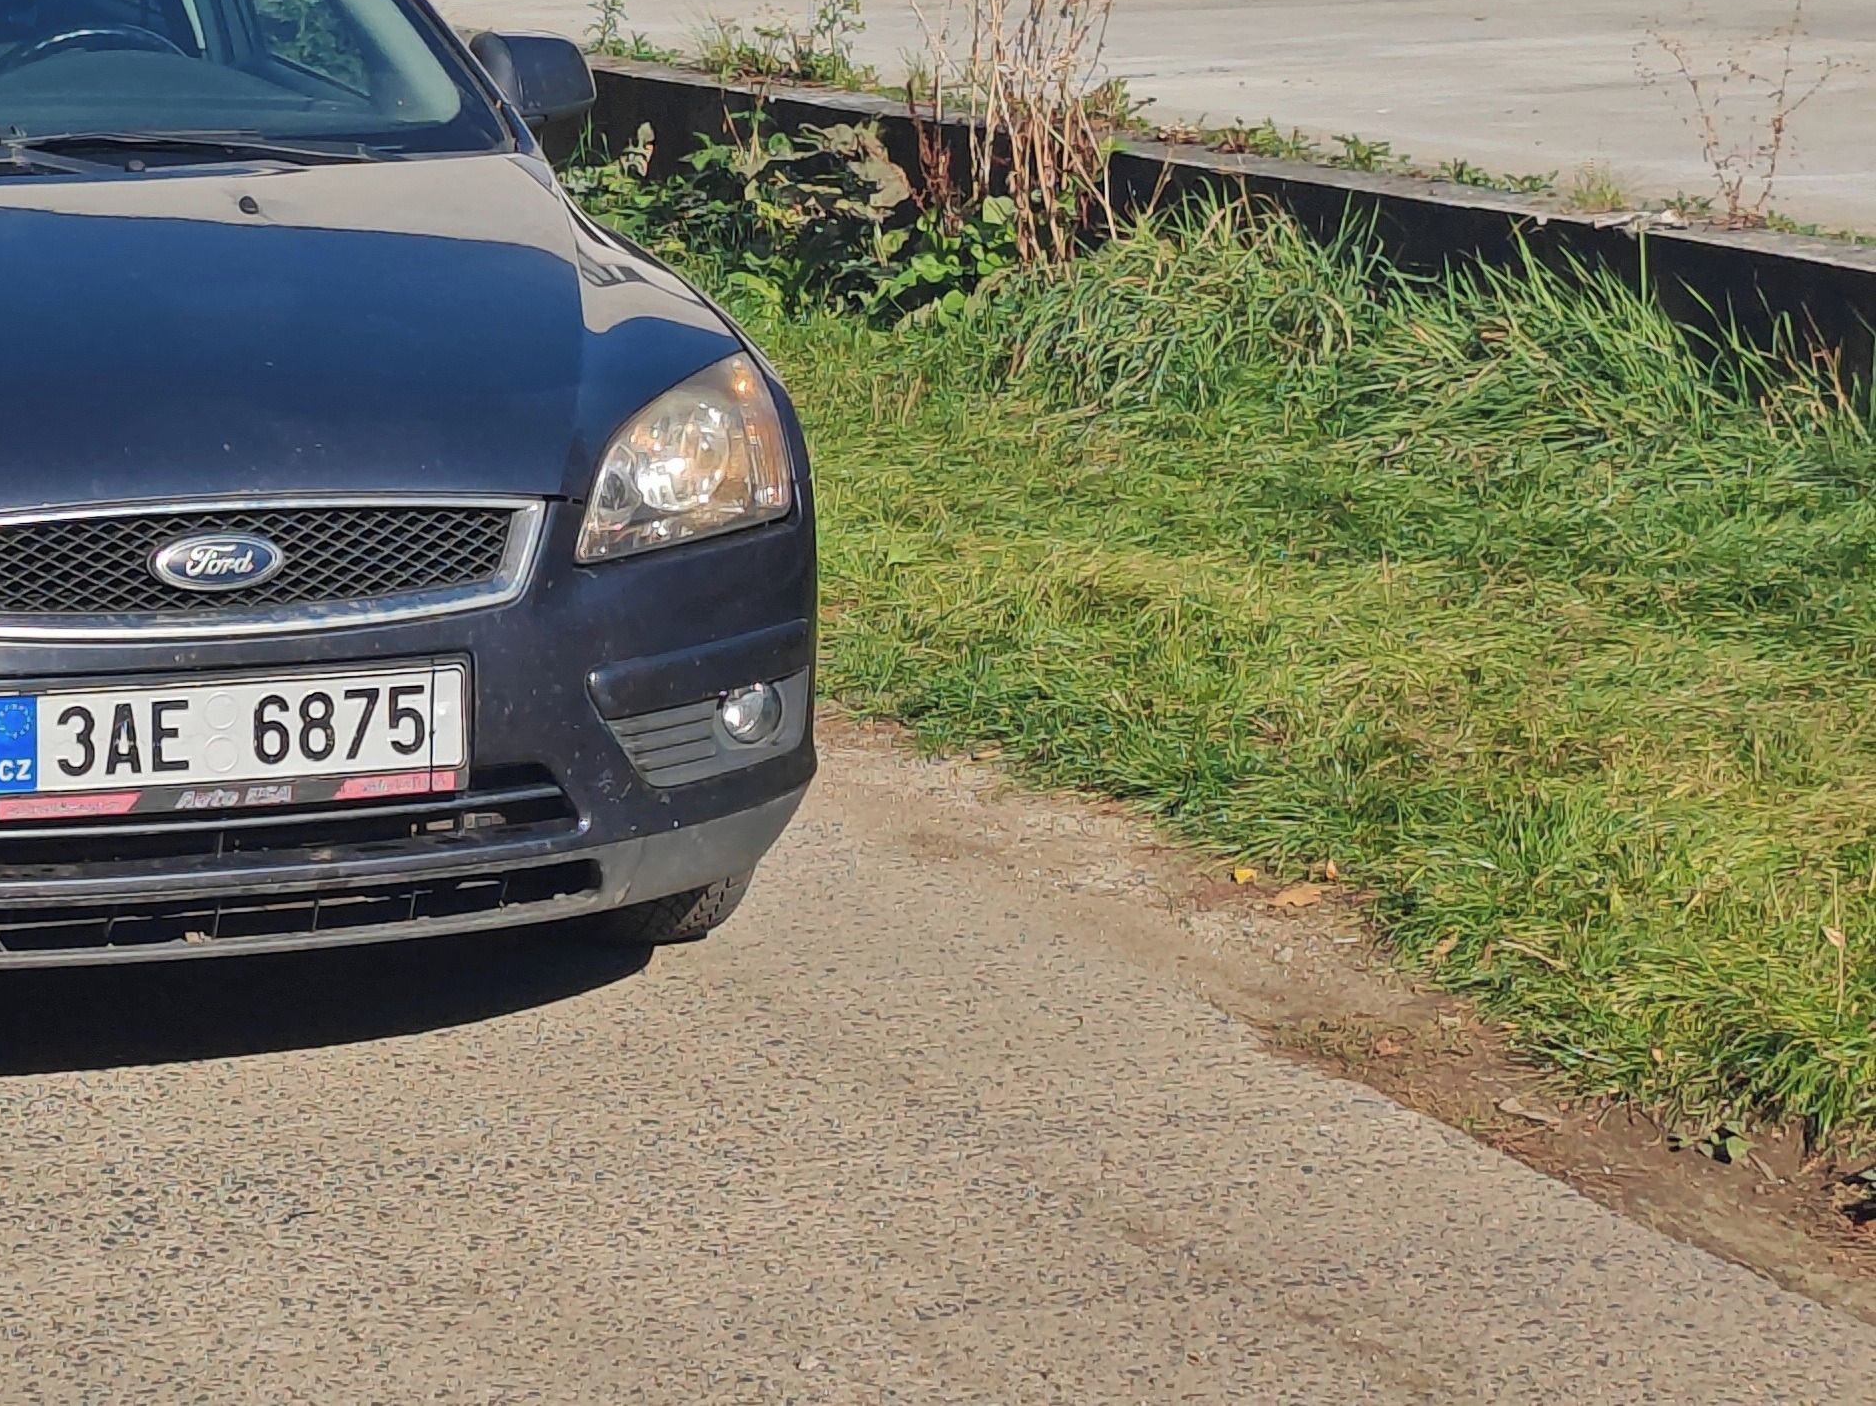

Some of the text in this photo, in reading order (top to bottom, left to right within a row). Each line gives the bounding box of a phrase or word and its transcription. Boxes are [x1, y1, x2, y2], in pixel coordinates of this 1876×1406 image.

[186, 544, 254, 576] Ford
[56, 685, 426, 777] 3AE 6875
